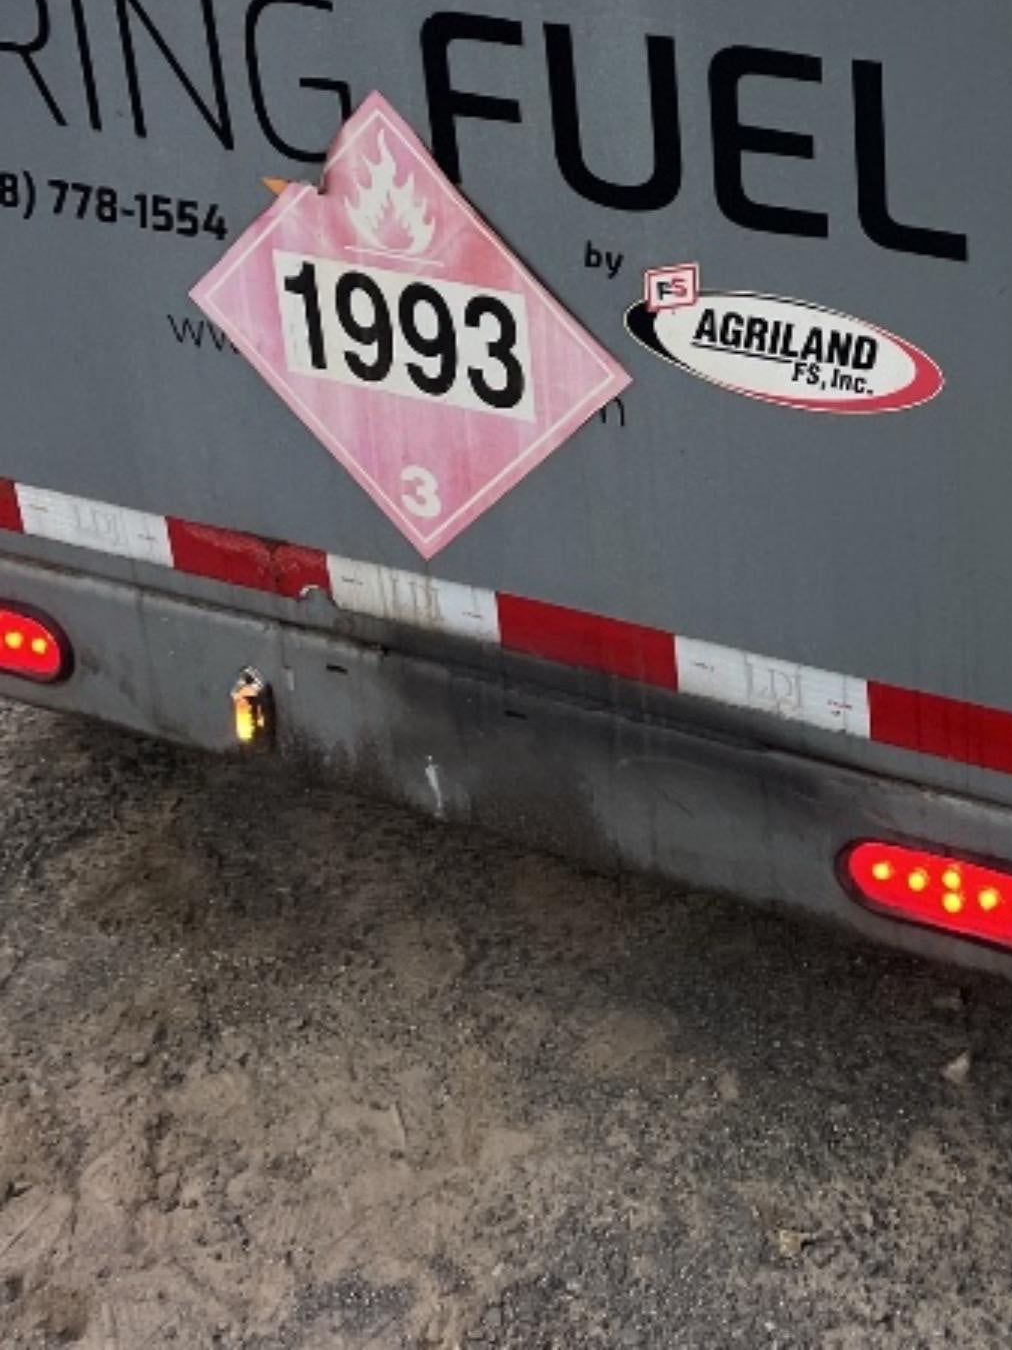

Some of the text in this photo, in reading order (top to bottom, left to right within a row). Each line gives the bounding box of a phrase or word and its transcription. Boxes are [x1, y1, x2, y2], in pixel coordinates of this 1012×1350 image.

[420, 11, 969, 263] FUEL
[48, 179, 228, 241] 778-1554
[584, 240, 624, 279] by
[656, 277, 688, 301] FS
[284, 260, 525, 410] 1993
[692, 307, 878, 371] AGRILAND
[791, 361, 875, 395] FS, Inc.
[400, 465, 442, 519] 3
